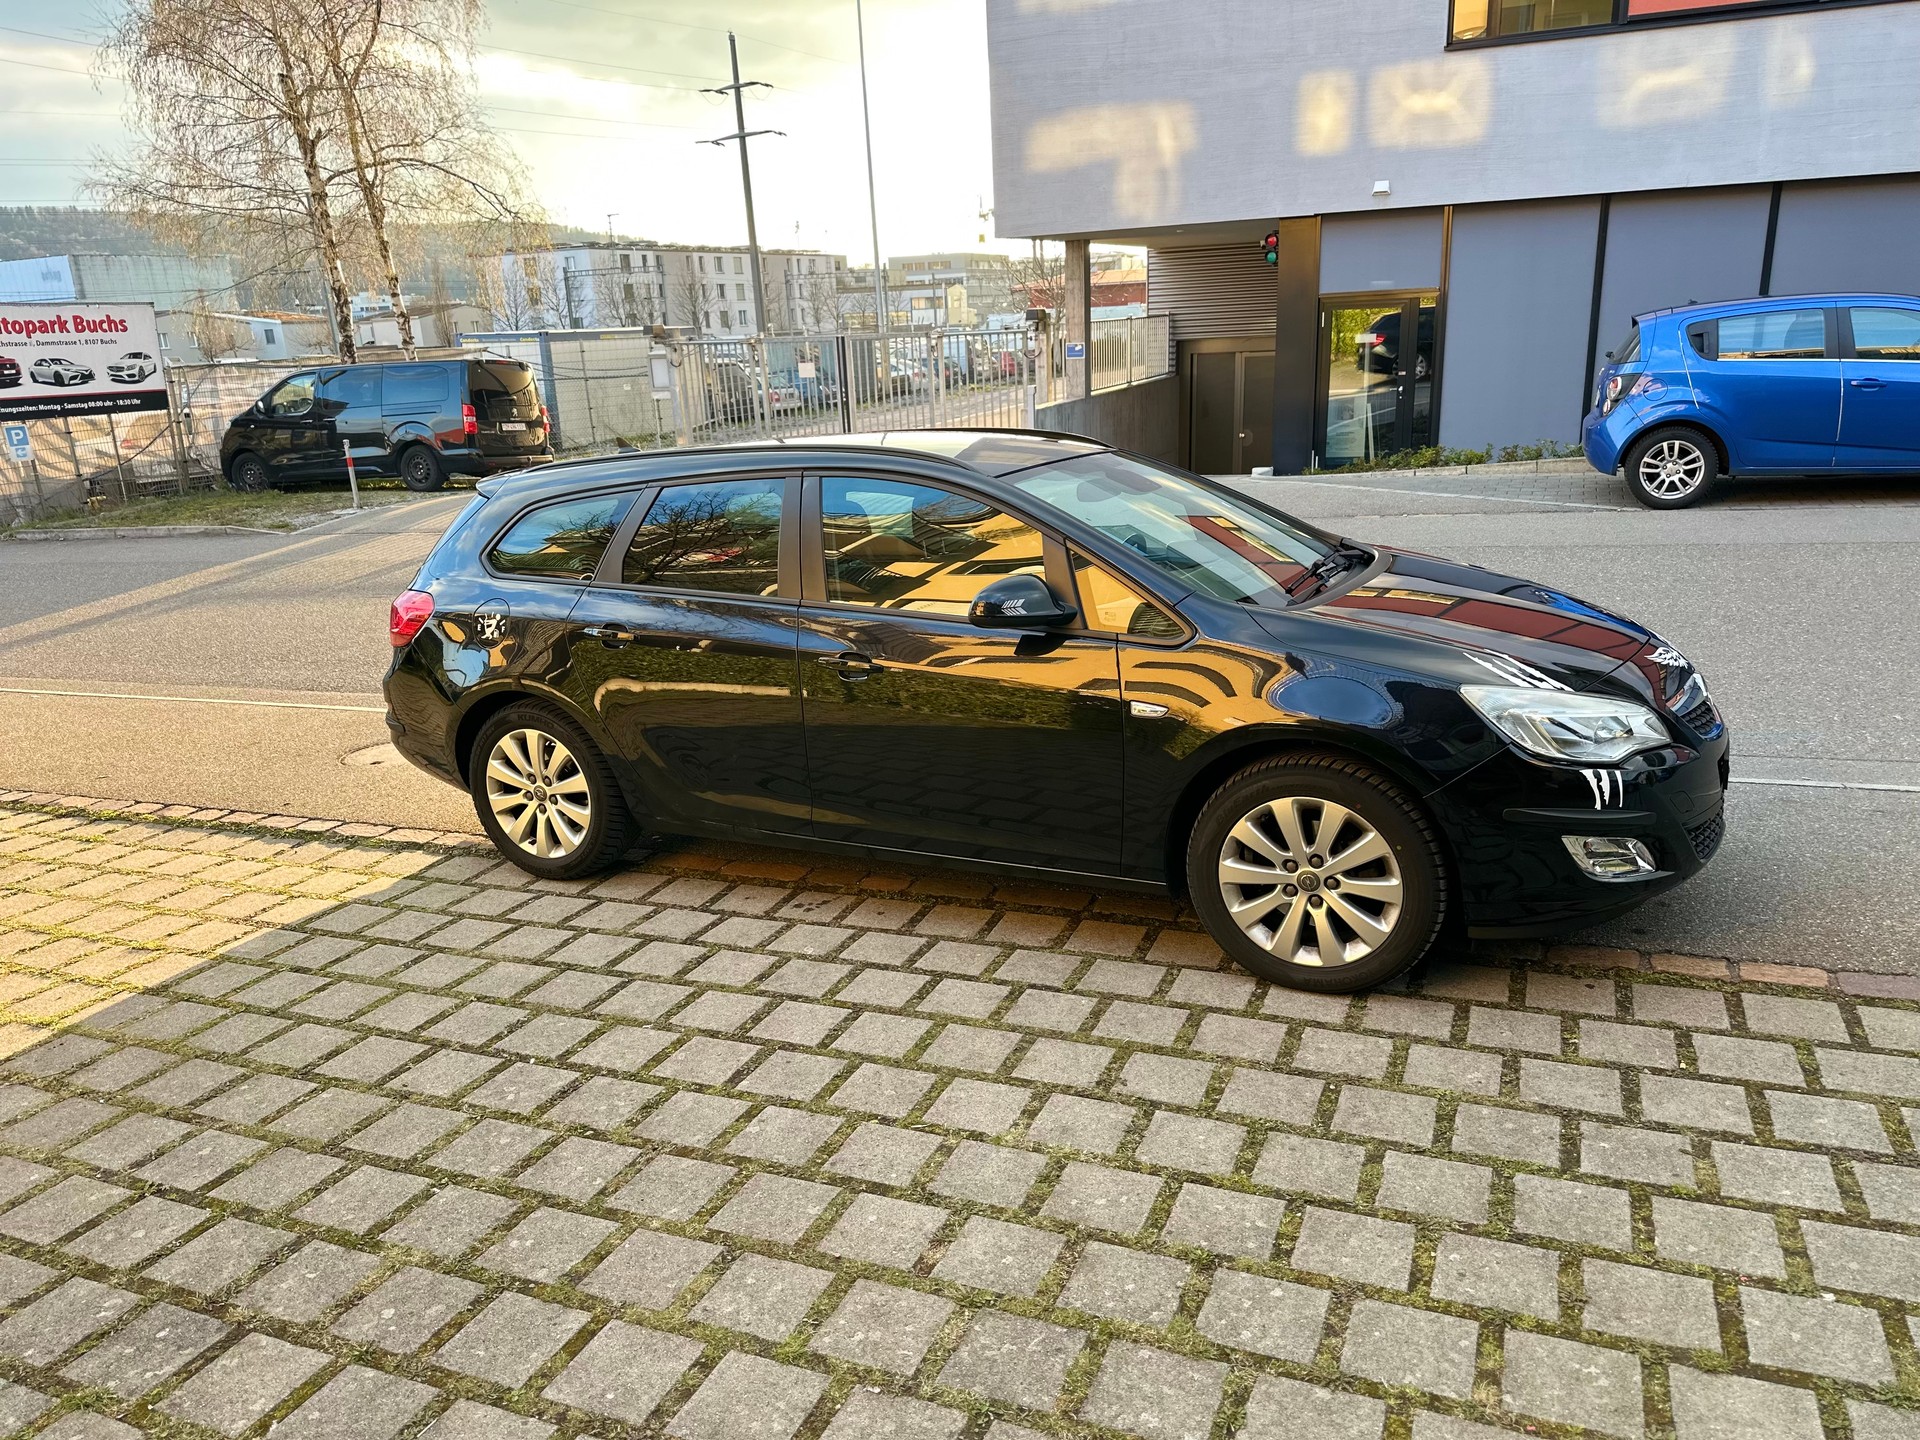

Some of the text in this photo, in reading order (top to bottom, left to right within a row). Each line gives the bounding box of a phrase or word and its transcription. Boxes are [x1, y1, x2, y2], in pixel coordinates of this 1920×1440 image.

[0, 314, 128, 339] topark Buchs
[36, 339, 77, 347] Dammstrasse
[0, 405, 38, 414] nungszeiten:
[38, 403, 61, 411] Montag
[11, 429, 24, 445] P
[517, 714, 554, 729] KUMHO
